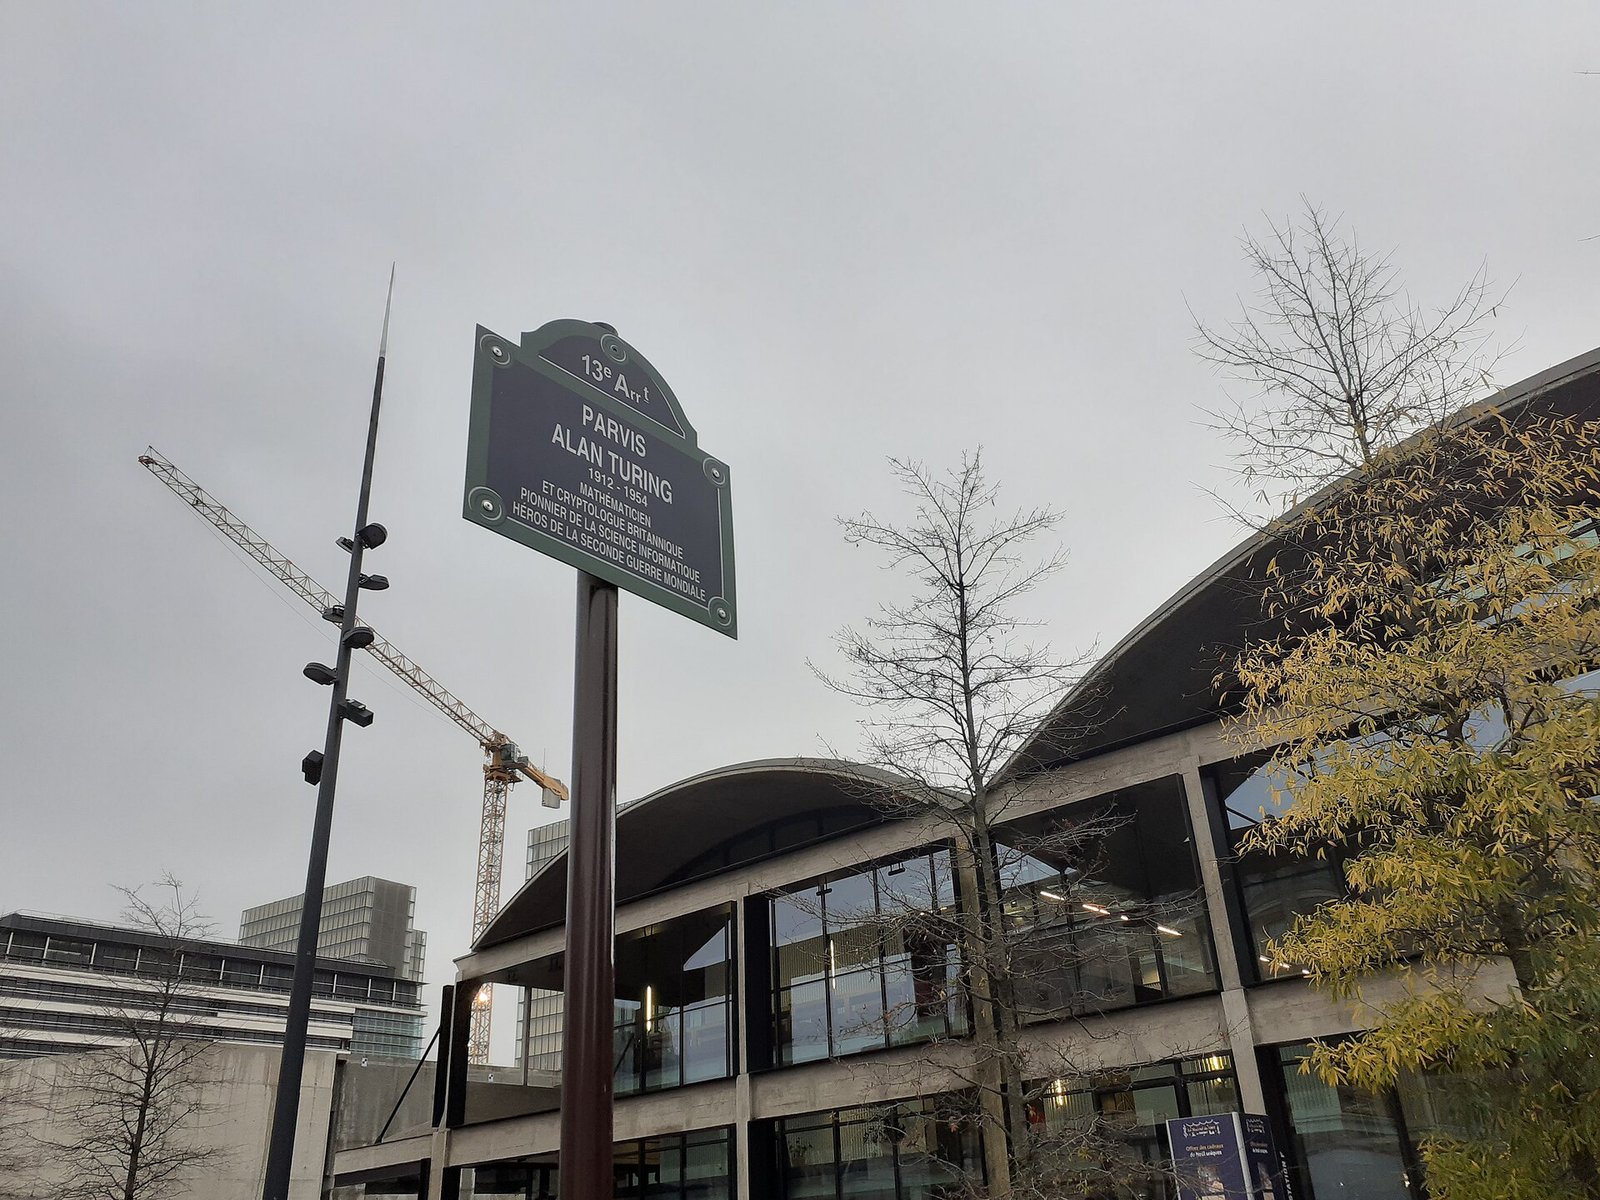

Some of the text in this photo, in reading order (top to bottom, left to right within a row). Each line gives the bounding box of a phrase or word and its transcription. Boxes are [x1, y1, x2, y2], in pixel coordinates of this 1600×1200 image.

[551, 423, 673, 504] ALAN TURING
[582, 404, 646, 457] PARVIS
[542, 480, 684, 560] ET CRYPTOLOGUE BRITANNIQUE
[579, 481, 651, 528] MATHÉMATICIEN
[588, 467, 614, 490] 1912
[624, 485, 648, 507] 1954
[512, 501, 707, 602] HÉROS DE LA SECONDE GUERRE MONDIALE
[520, 486, 701, 583] PIONNIER DE LA SCIENCE INFORMATIQUE
